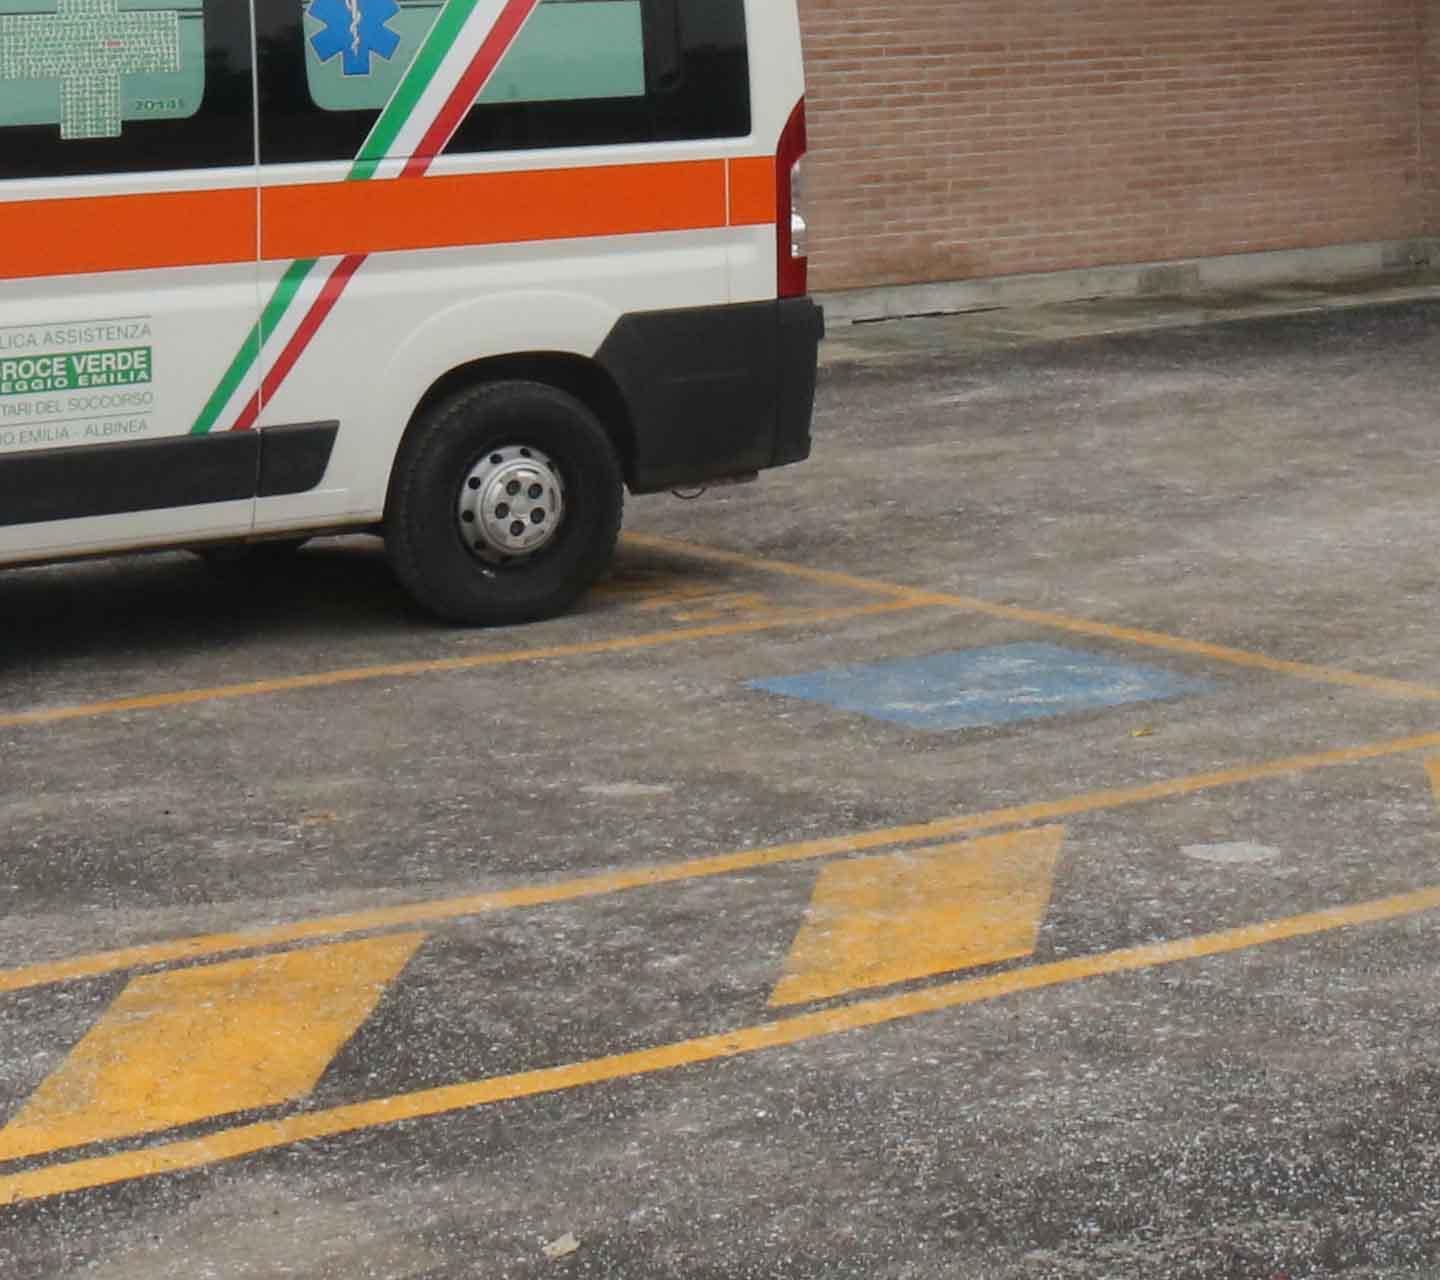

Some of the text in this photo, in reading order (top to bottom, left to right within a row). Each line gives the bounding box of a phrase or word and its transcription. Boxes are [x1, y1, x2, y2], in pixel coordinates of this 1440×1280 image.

[42, 323, 152, 345] ASSISTENZA
[72, 349, 148, 374] VERDE
[78, 371, 150, 386] EMILIA
[35, 399, 61, 415] DEL
[68, 391, 153, 410] SOCCORSO
[18, 425, 70, 444] EMILIA
[85, 418, 148, 437] ALBINEA
